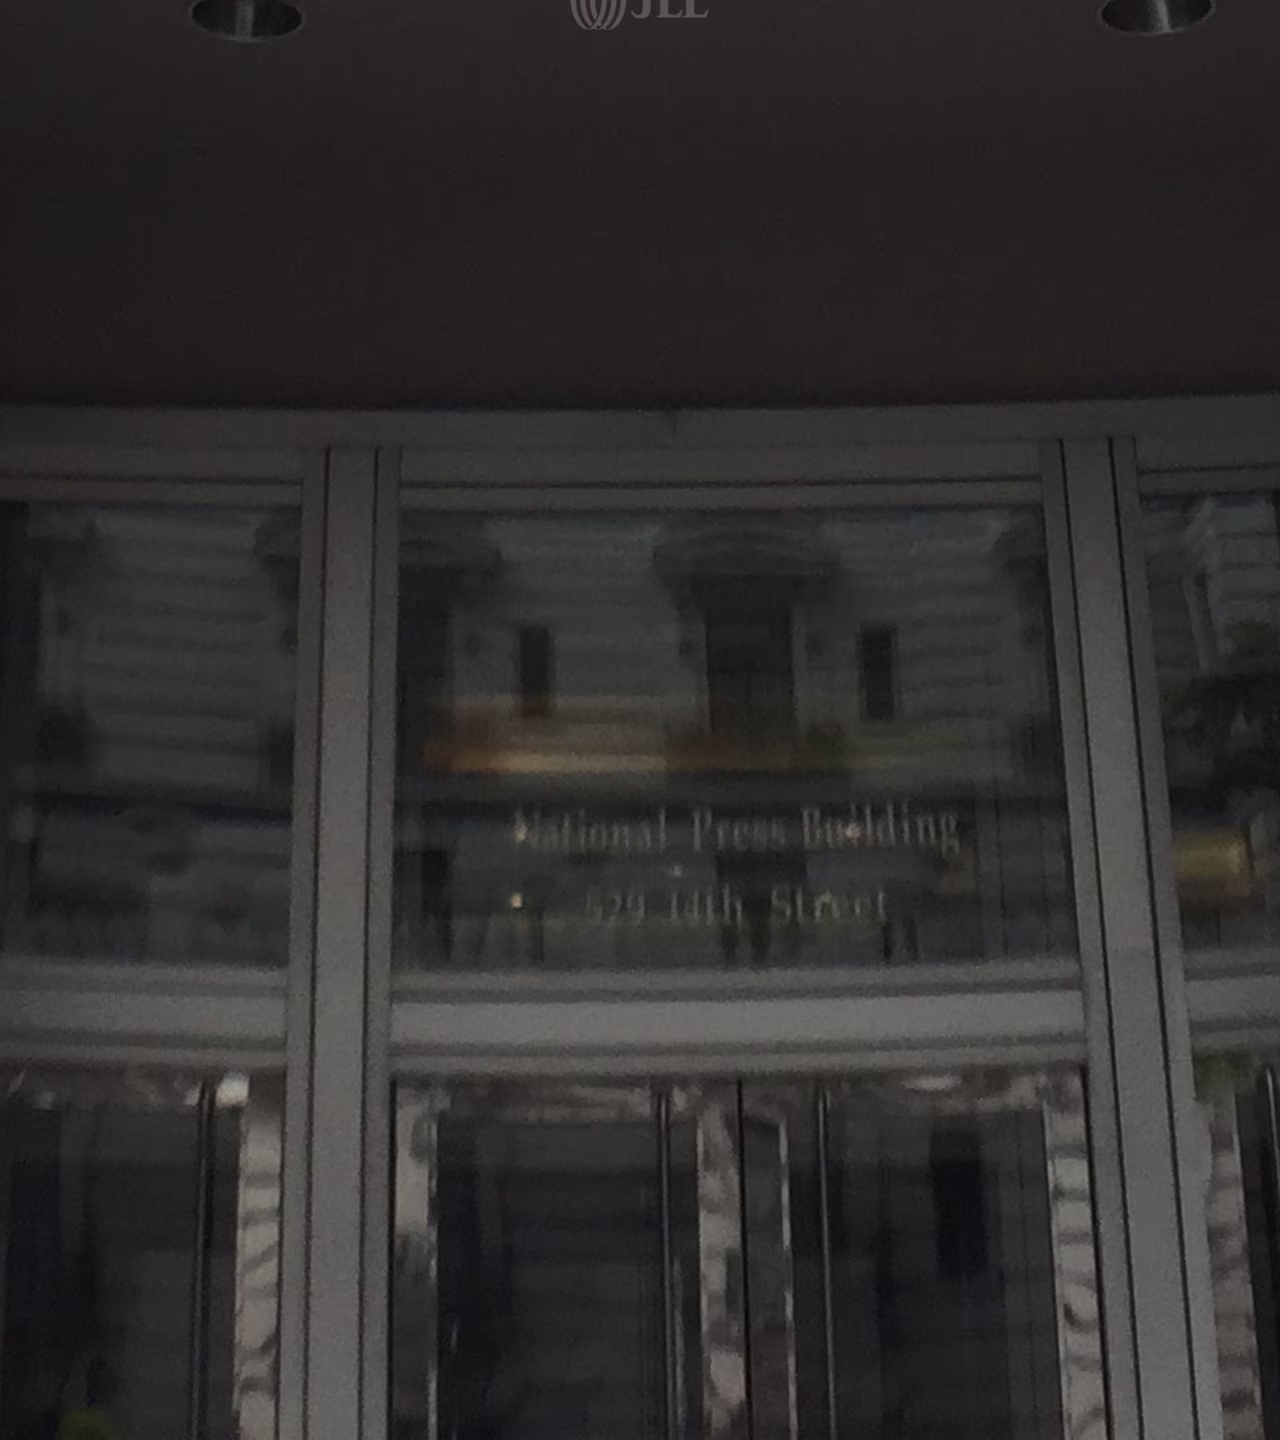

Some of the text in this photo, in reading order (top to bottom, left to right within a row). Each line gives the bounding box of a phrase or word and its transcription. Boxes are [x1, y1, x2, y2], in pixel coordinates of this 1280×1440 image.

[515, 802, 961, 855] National Press Building
[669, 885, 744, 926] 14th
[771, 887, 887, 925] Street
